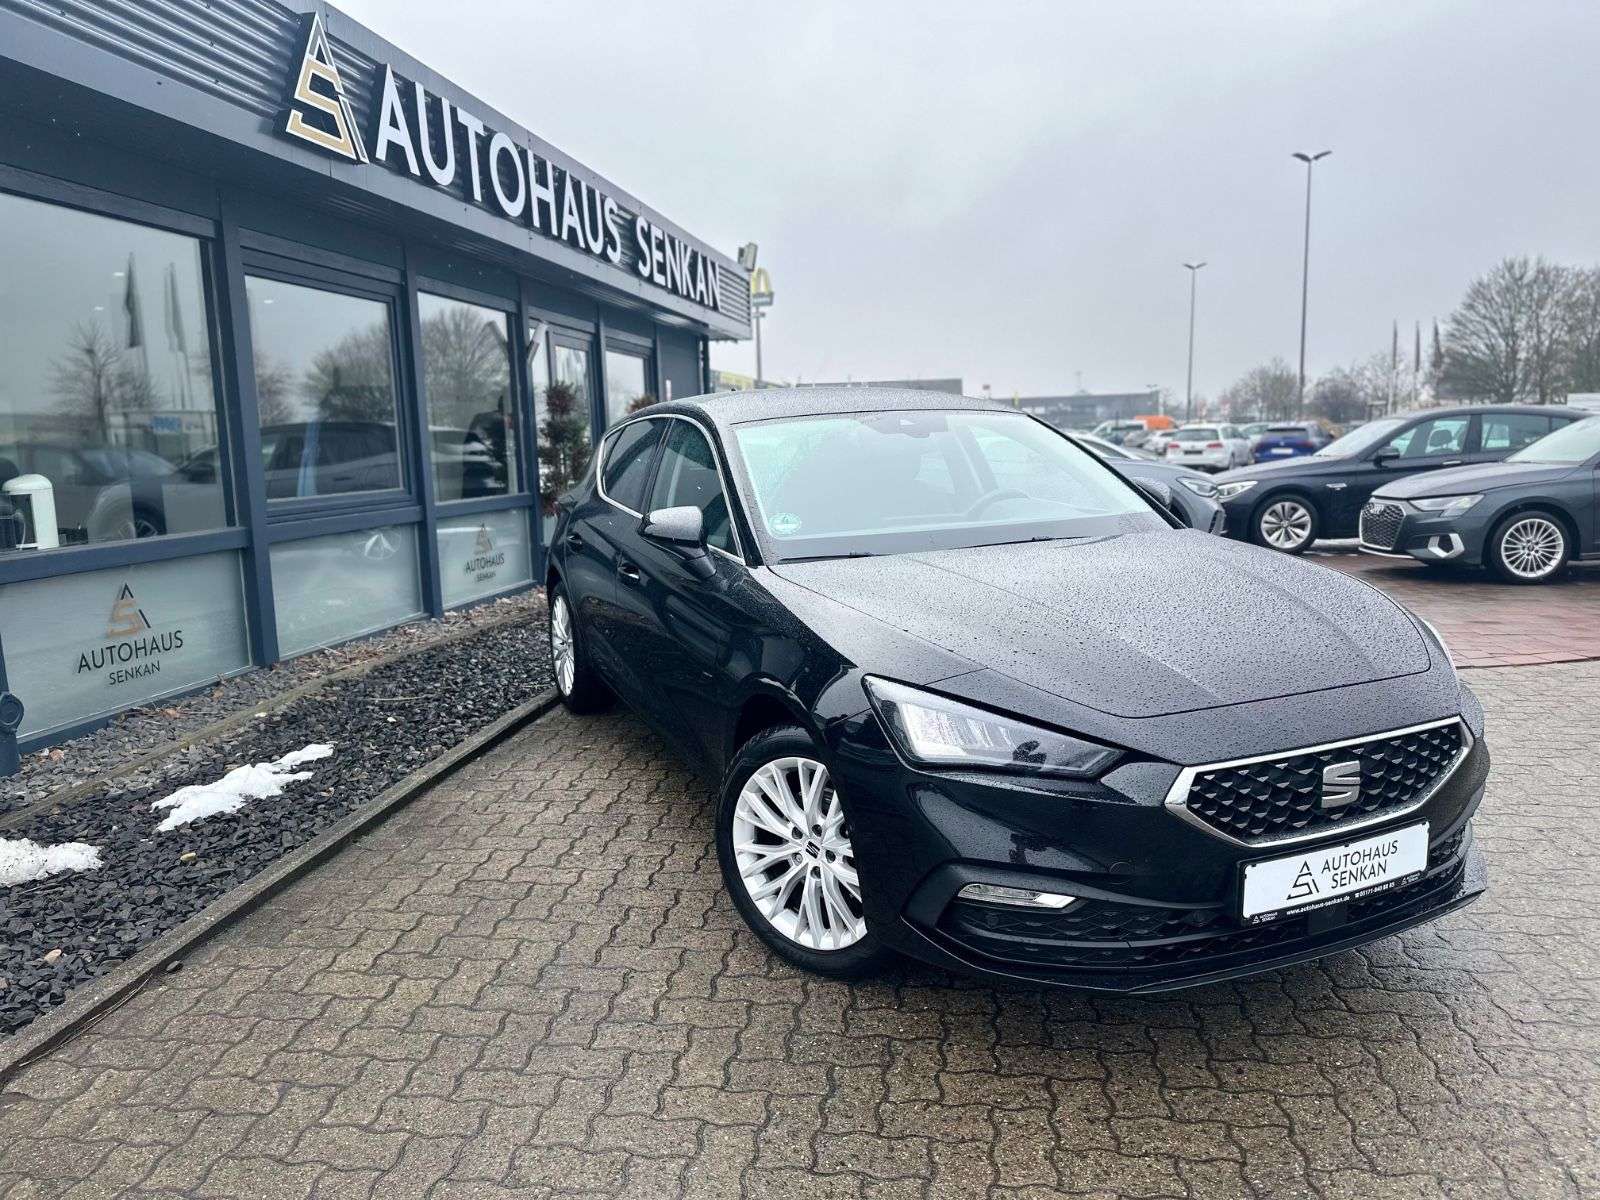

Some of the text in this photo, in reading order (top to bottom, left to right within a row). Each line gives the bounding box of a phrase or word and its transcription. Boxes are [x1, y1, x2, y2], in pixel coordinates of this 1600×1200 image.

[376, 63, 720, 312] AUTOHAUS SENKAN
[78, 630, 183, 674] AUTOHAUS
[109, 660, 161, 686] SENKAN
[1321, 840, 1399, 874] AUTOHAUS
[1331, 859, 1387, 889] SENKAN
